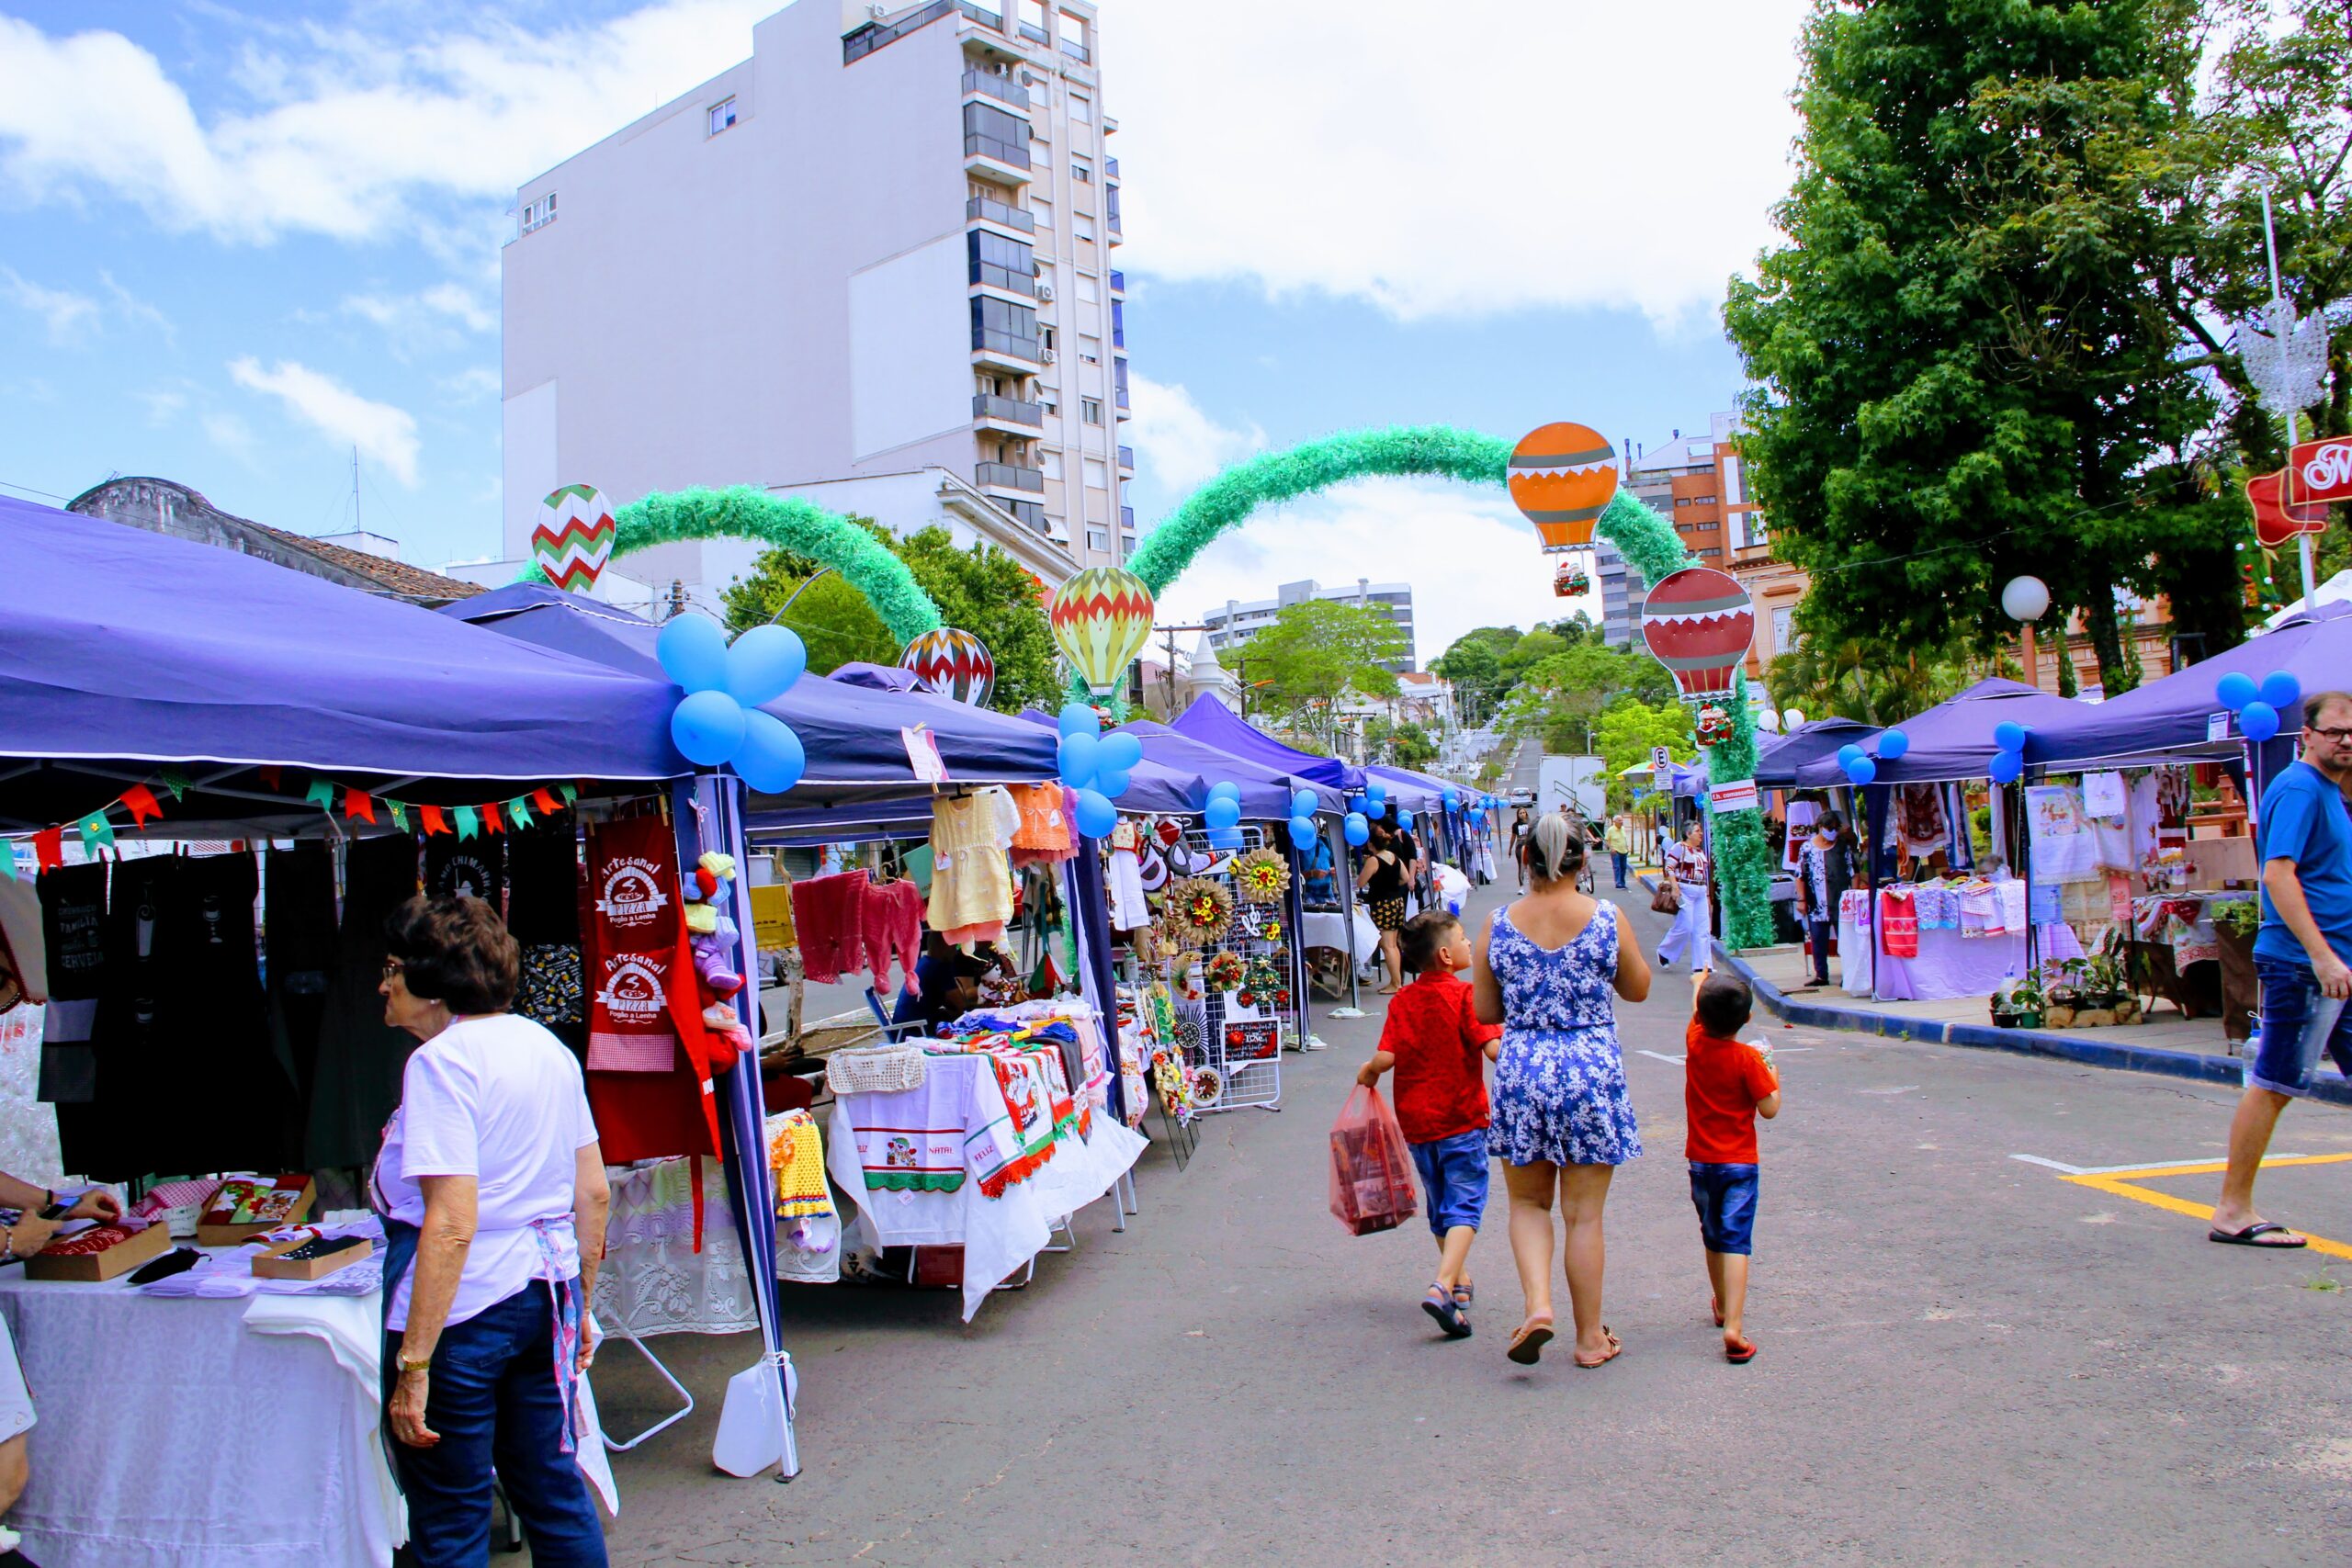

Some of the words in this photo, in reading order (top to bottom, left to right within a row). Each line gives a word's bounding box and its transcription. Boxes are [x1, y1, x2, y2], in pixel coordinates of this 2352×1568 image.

[1658, 751, 1665, 764] E
[602, 856, 662, 879] Artesanal
[605, 953, 667, 975] Artesanal
[974, 1145, 995, 1162] FELIZ
